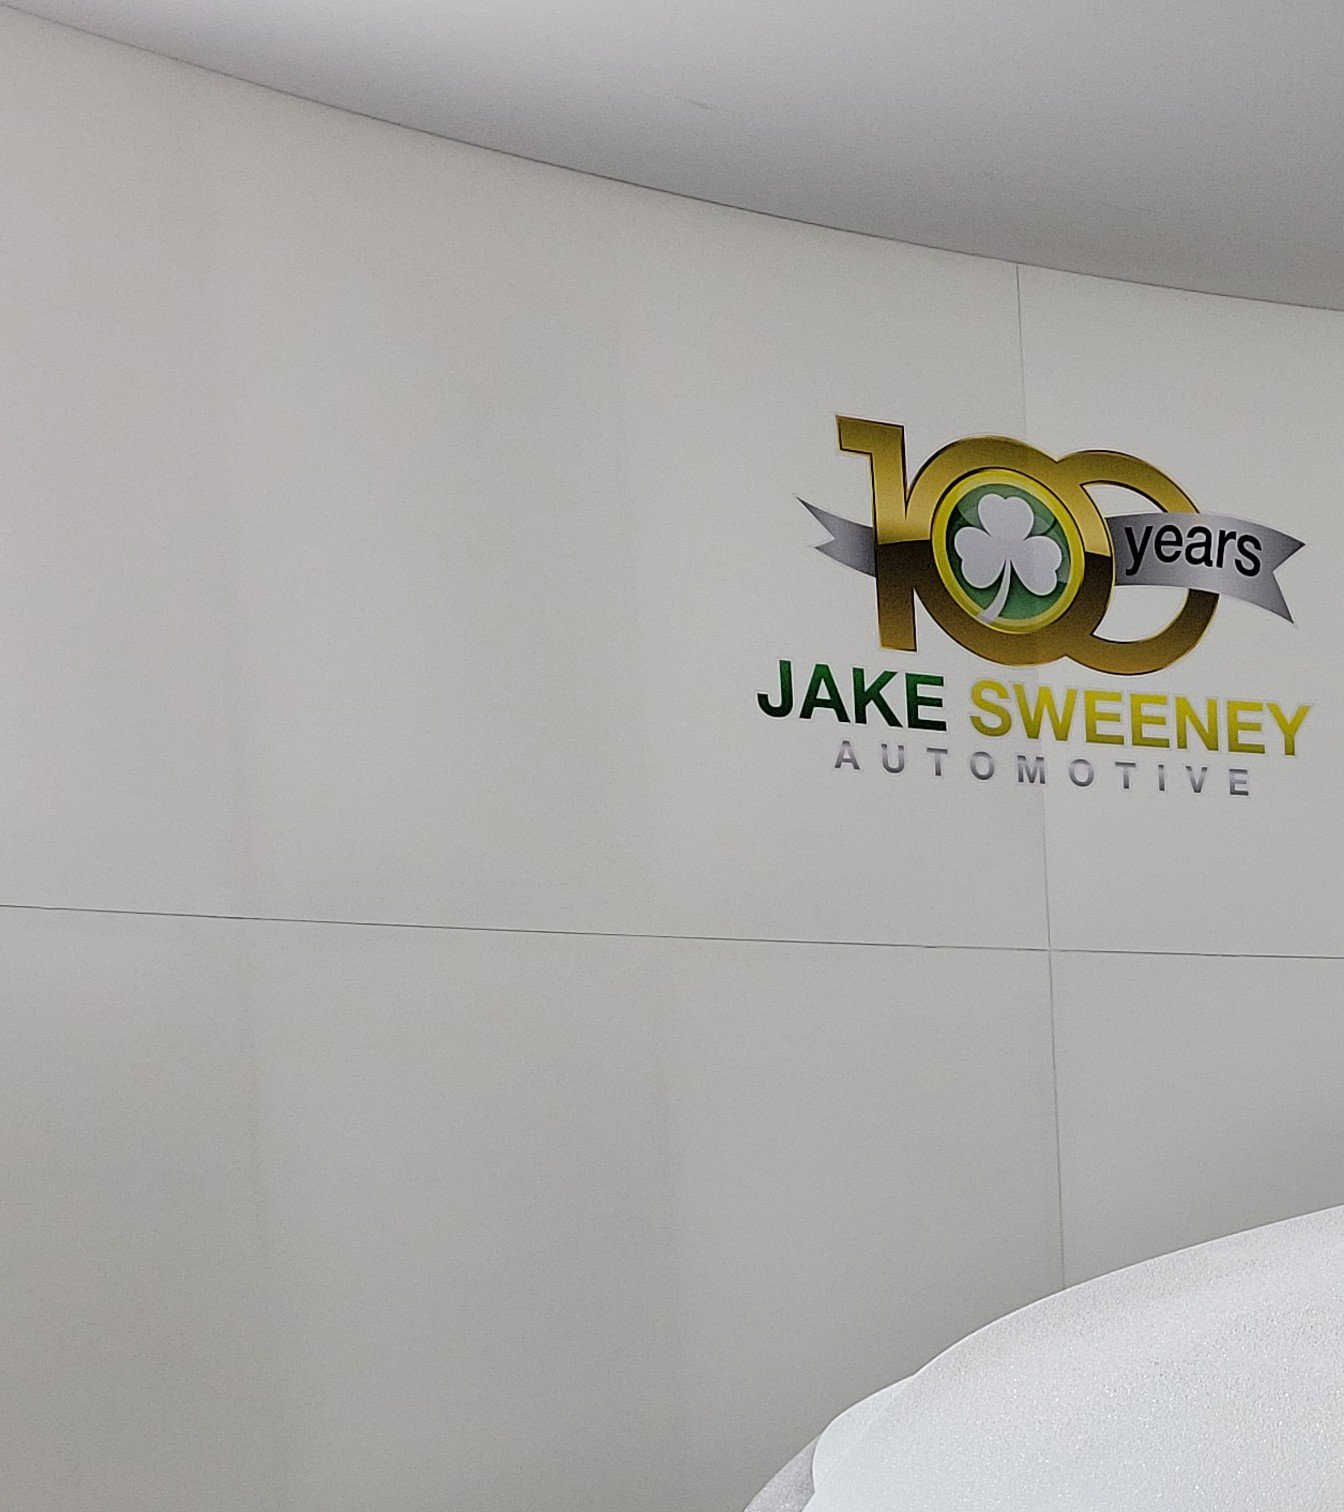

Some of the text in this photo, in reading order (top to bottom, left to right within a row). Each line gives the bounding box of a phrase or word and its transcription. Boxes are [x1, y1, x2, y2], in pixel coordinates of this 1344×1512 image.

[834, 414, 1262, 674] 100 years
[757, 660, 1310, 756] JAKE SWEENEY
[834, 740, 1250, 796] AUTOMOTIVE
